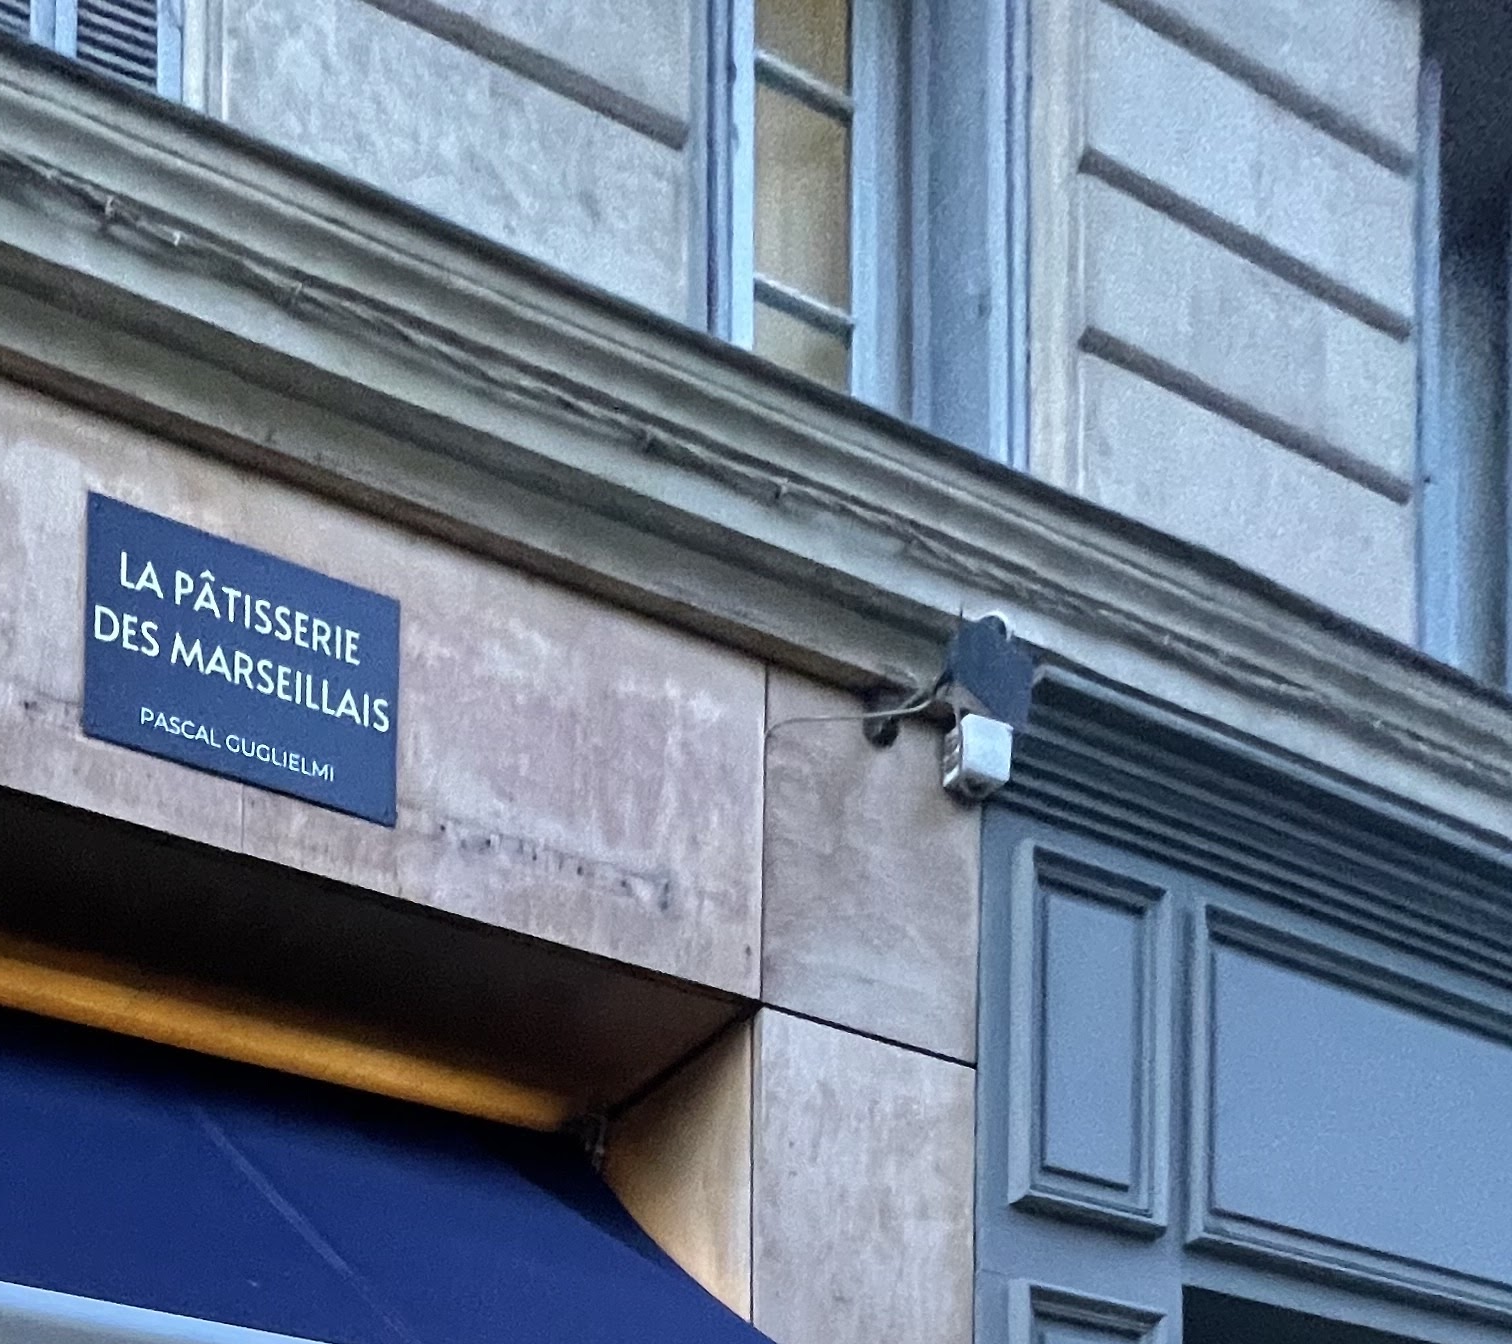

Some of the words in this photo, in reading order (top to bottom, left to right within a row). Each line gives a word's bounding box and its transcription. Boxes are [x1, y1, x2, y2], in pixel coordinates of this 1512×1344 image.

[119, 550, 165, 600] LA
[173, 569, 362, 667] PÂTISSERIE
[93, 604, 161, 658] DES
[170, 632, 390, 734] MARSEILLAIS
[140, 706, 222, 749] PASCAL
[225, 734, 336, 783] GUGLIELMI
